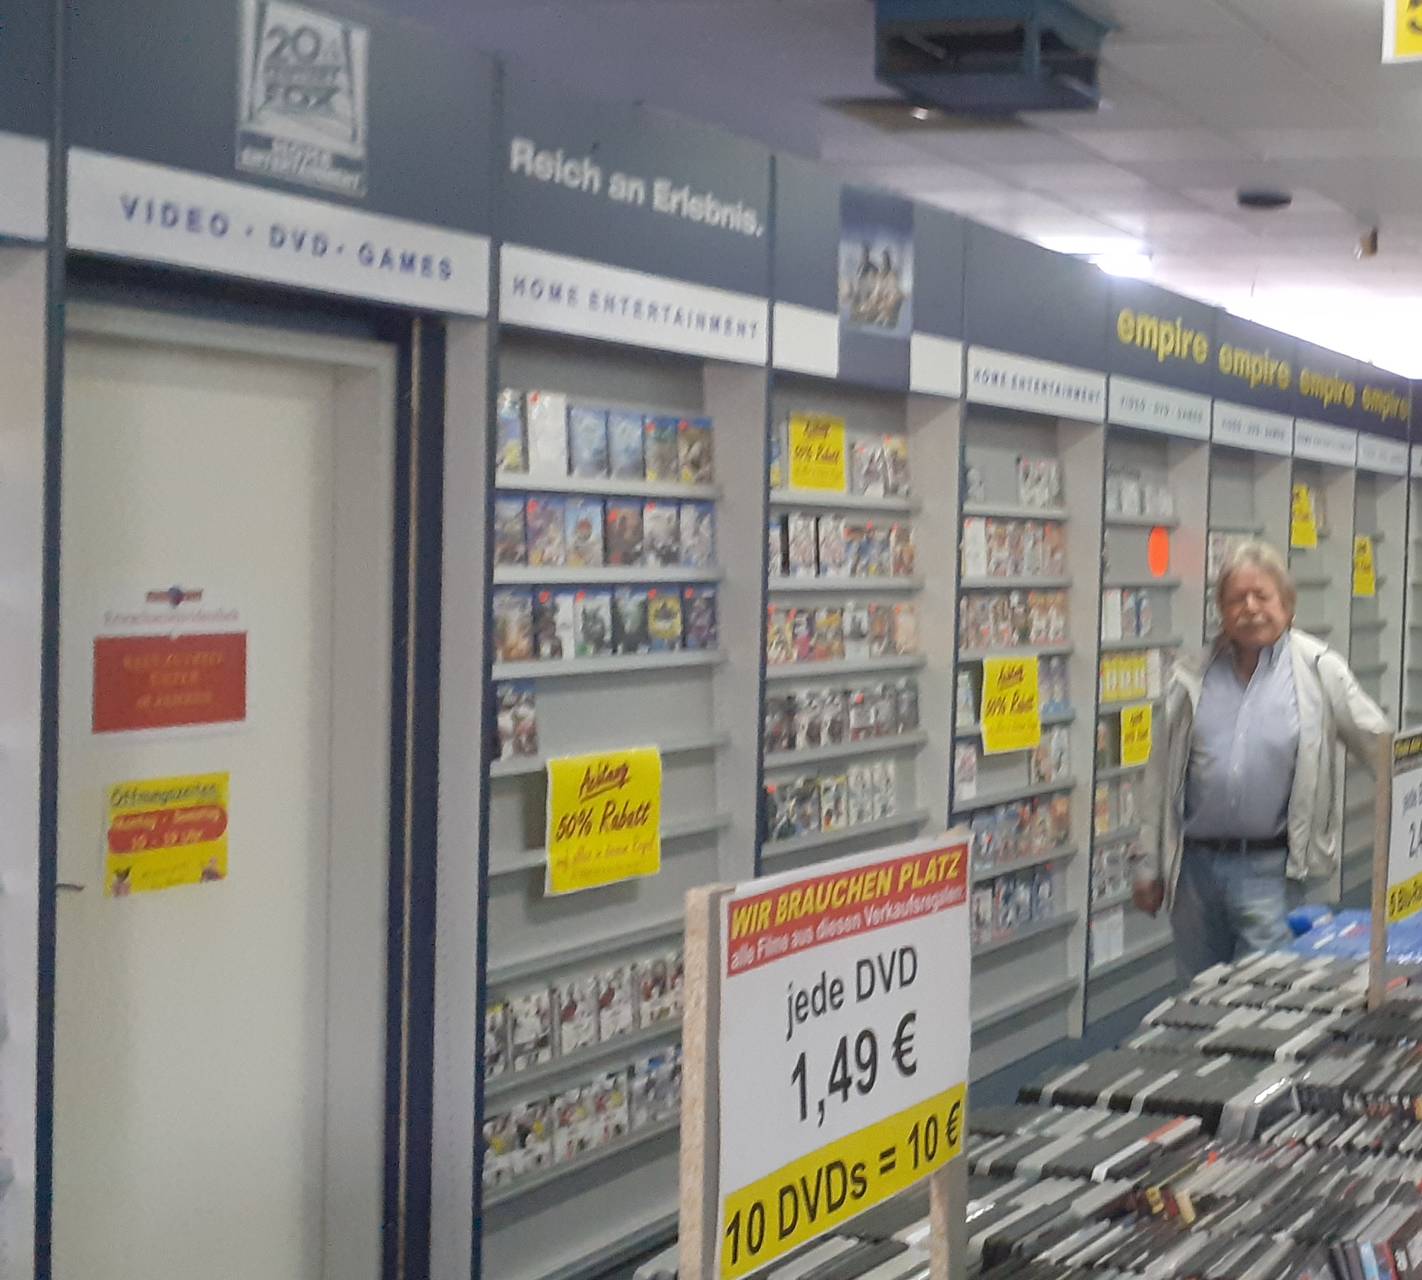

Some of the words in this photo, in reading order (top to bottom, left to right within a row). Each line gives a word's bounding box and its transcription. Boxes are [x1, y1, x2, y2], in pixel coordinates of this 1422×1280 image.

[511, 137, 600, 195] Reich
[607, 172, 645, 205] an
[653, 177, 764, 238] Erlebnis.
[120, 193, 231, 238] VIDEO
[269, 224, 329, 258] DVD
[358, 241, 452, 281] GAMES
[512, 274, 579, 304] HOME
[588, 291, 758, 340] ENTERTAINMENT
[1117, 307, 1209, 364] empire
[1218, 342, 1291, 390] empire
[1301, 367, 1356, 410] empire
[556, 807, 593, 842] 50%
[599, 800, 652, 834] Rabatt
[731, 899, 772, 941] WIR
[774, 866, 894, 928] BRAUCHEN
[897, 851, 963, 893] PLATZ
[731, 946, 754, 971] alle
[757, 932, 788, 960] Filme
[791, 924, 814, 948] aus
[816, 911, 862, 940] diesen
[785, 970, 845, 1042] jede
[855, 945, 918, 1004] DVD
[789, 1027, 879, 1128] 1,49
[892, 1012, 918, 1077] €
[725, 1200, 765, 1267] 10
[777, 1158, 868, 1243] DVDs
[878, 1144, 898, 1176] =
[907, 1113, 940, 1172] 10
[943, 1099, 962, 1149] €
